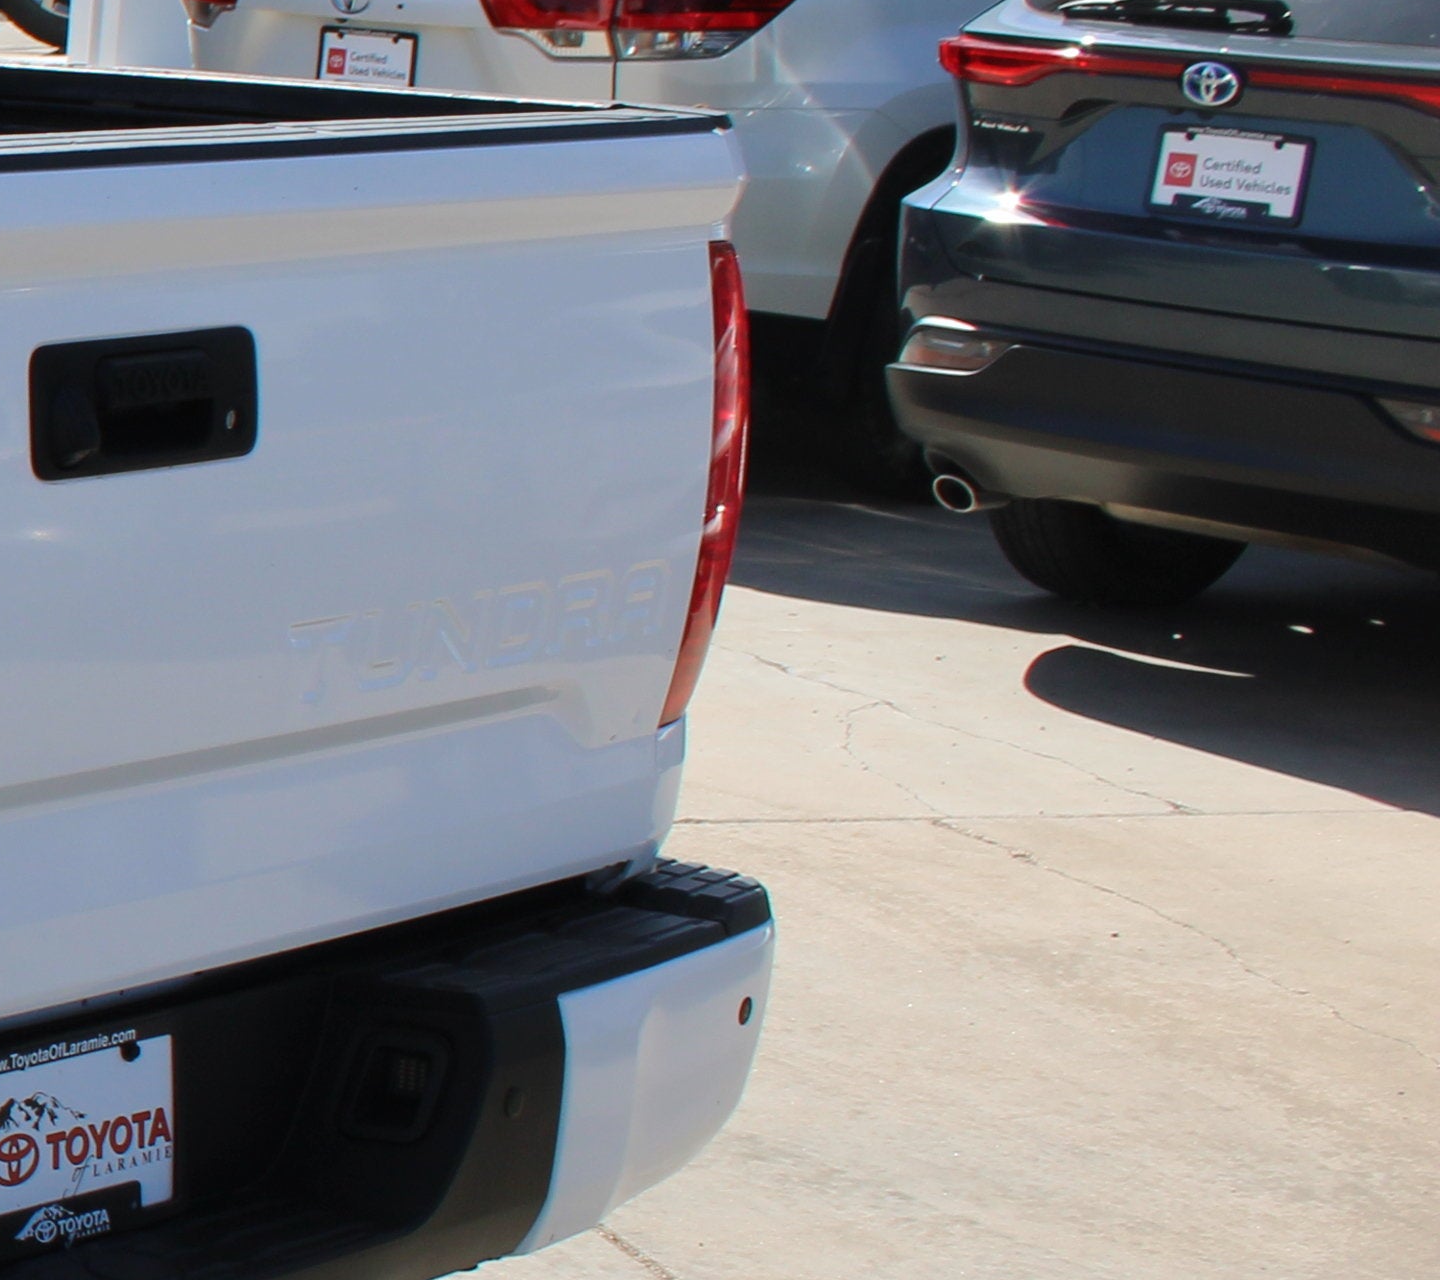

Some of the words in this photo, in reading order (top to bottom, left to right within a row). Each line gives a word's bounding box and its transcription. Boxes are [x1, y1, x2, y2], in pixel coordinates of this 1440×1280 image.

[349, 51, 388, 65] Certified
[1202, 157, 1264, 175] Certified
[1199, 174, 1233, 190] Used
[1235, 177, 1292, 196] Vehicles
[288, 558, 672, 704] TUNDRA
[46, 1107, 172, 1170] TOYOTA
[92, 1145, 174, 1178] LARAMIE
[57, 1208, 110, 1236] TOYOTA
